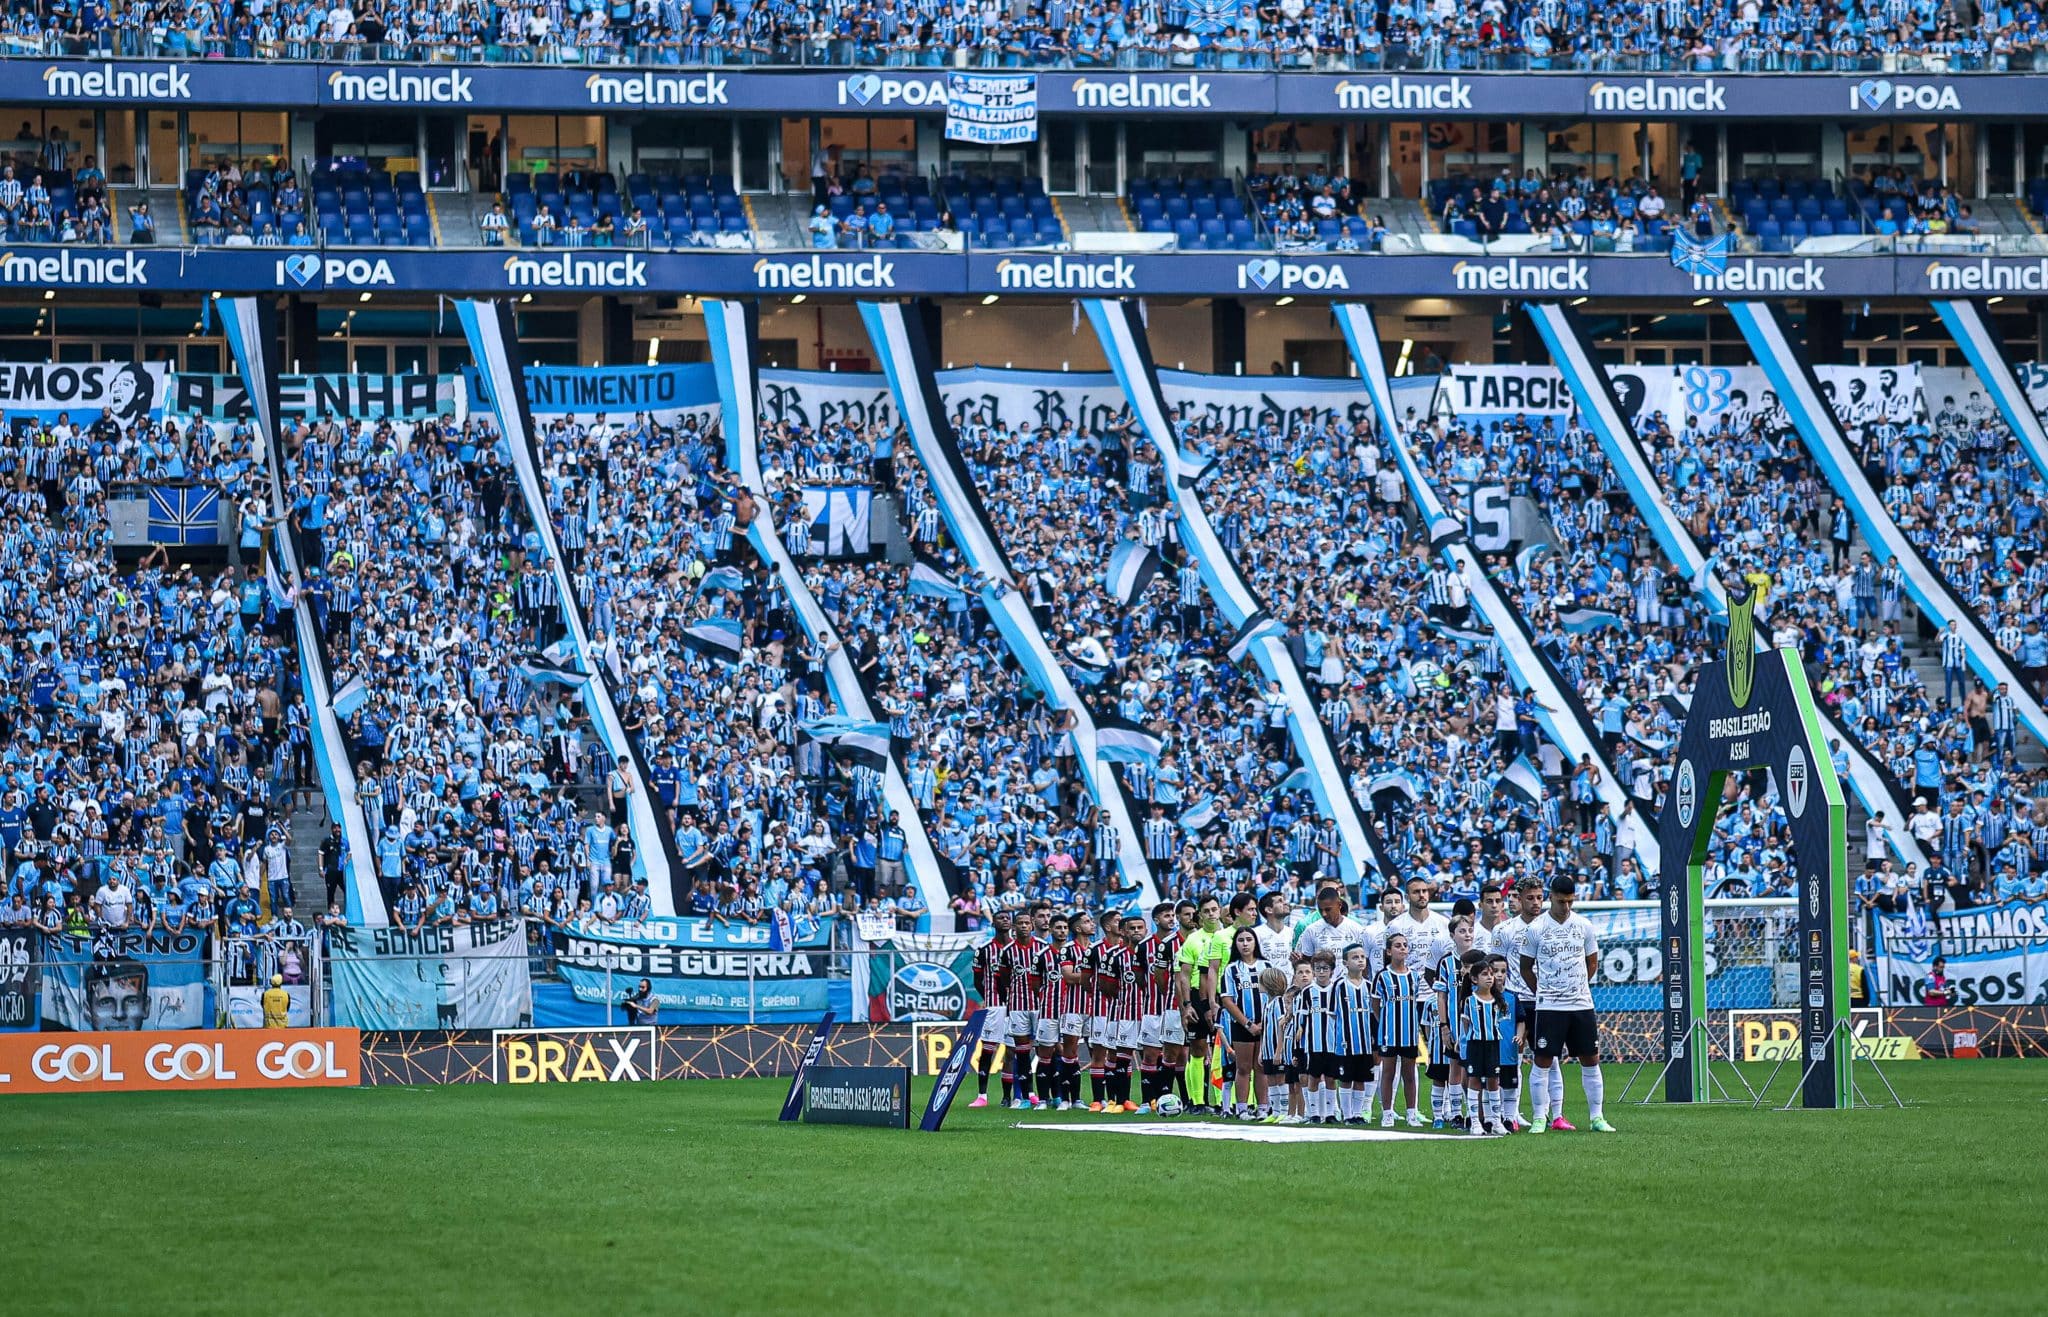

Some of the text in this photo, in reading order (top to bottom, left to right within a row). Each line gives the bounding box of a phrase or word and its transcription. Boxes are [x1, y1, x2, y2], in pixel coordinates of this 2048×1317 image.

[46, 64, 190, 98] melnick
[331, 69, 472, 102] melnick
[588, 73, 728, 104] melnick
[882, 80, 949, 105] POA
[968, 78, 1028, 93] SEMPRE
[1075, 75, 1211, 107] melnick
[1337, 77, 1472, 109] melnick
[1593, 79, 1726, 111] melnick
[984, 94, 1013, 106] PTE
[1895, 85, 1961, 111] POA
[4, 250, 147, 284] melnick
[325, 259, 395, 285] POA
[508, 254, 647, 287] melnick
[757, 255, 895, 288] melnick
[1000, 256, 1135, 289] melnick
[1281, 264, 1349, 290] POA
[1456, 259, 1589, 290] melnick
[524, 371, 675, 405] ENTIMENTO
[1683, 366, 1732, 415] 83
[1709, 706, 1771, 739] BRASILEIRÃO
[373, 926, 454, 955] SOMOS
[556, 938, 813, 977] JOGO É GUERRA
[894, 992, 961, 1012] GRÊMIO
[31, 1044, 124, 1082] GOL
[144, 1043, 236, 1081] GOL
[256, 1041, 347, 1079] GOL
[508, 1038, 641, 1084] BRAX
[810, 1081, 853, 1110] BRASILEIRÃO
[872, 1087, 891, 1113] 2023
